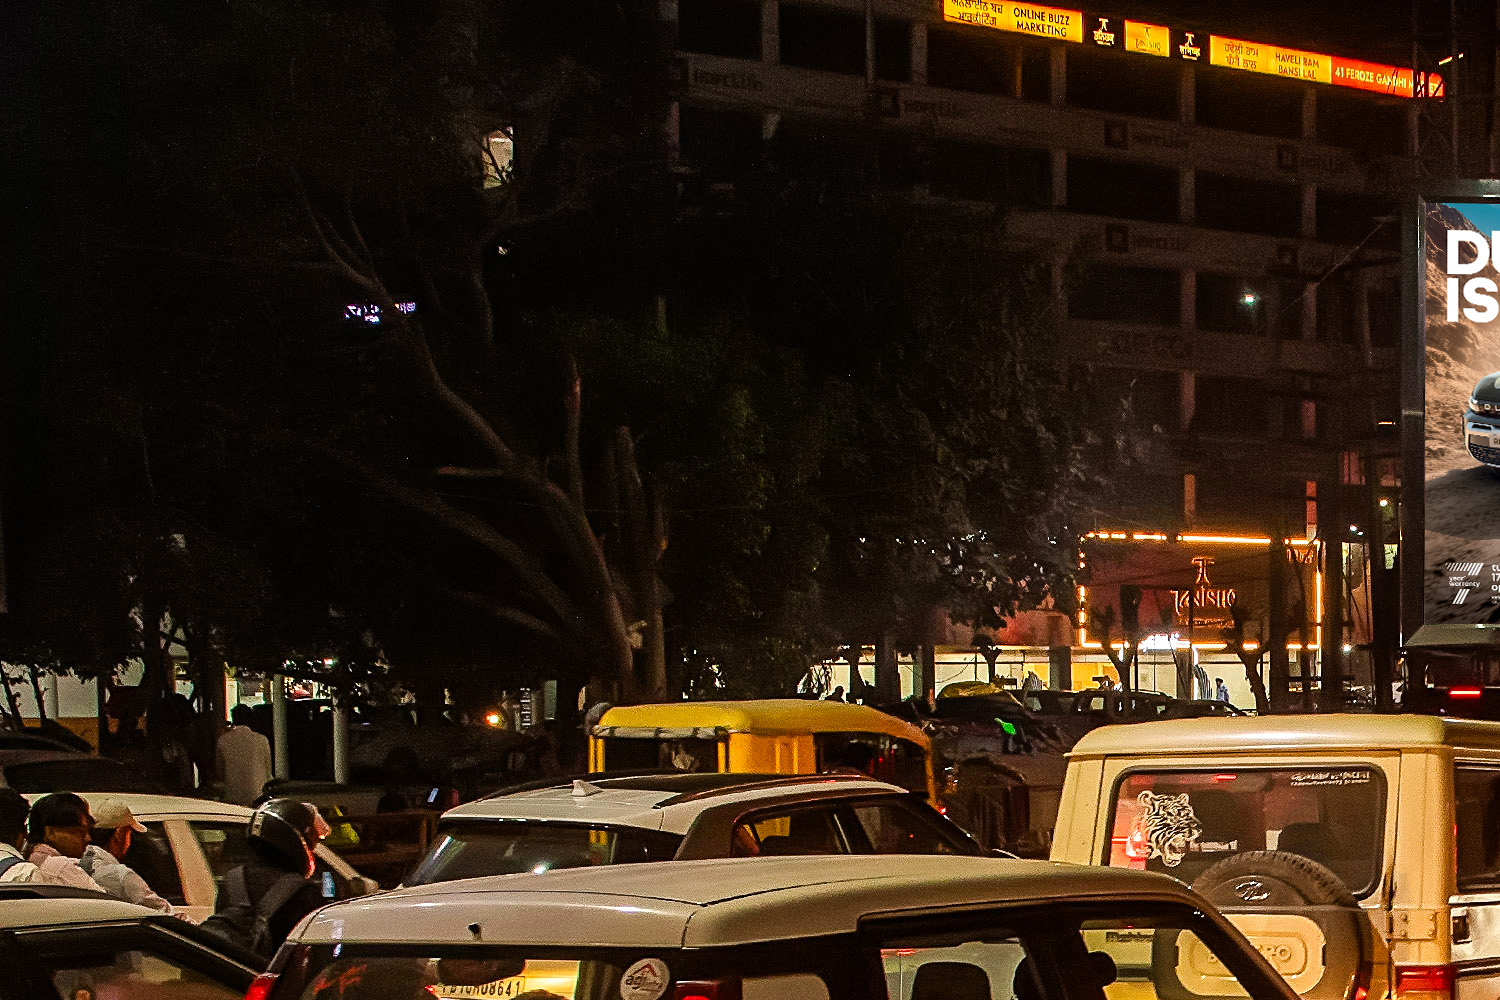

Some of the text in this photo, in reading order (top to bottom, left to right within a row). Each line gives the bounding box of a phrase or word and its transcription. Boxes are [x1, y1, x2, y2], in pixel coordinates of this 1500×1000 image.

[1013, 7, 1070, 26] ONLINE BUZZ
[1016, 21, 1067, 37] MARKETING
[1275, 52, 1319, 68] HAVELI RAM
[1278, 65, 1316, 80] BANSI LAL
[1335, 66, 1344, 79] 41
[1346, 68, 1374, 83] FEROZE
[1376, 73, 1407, 89] GANDHI
[1446, 279, 1499, 323] IS
[1491, 573, 1500, 582] 17
